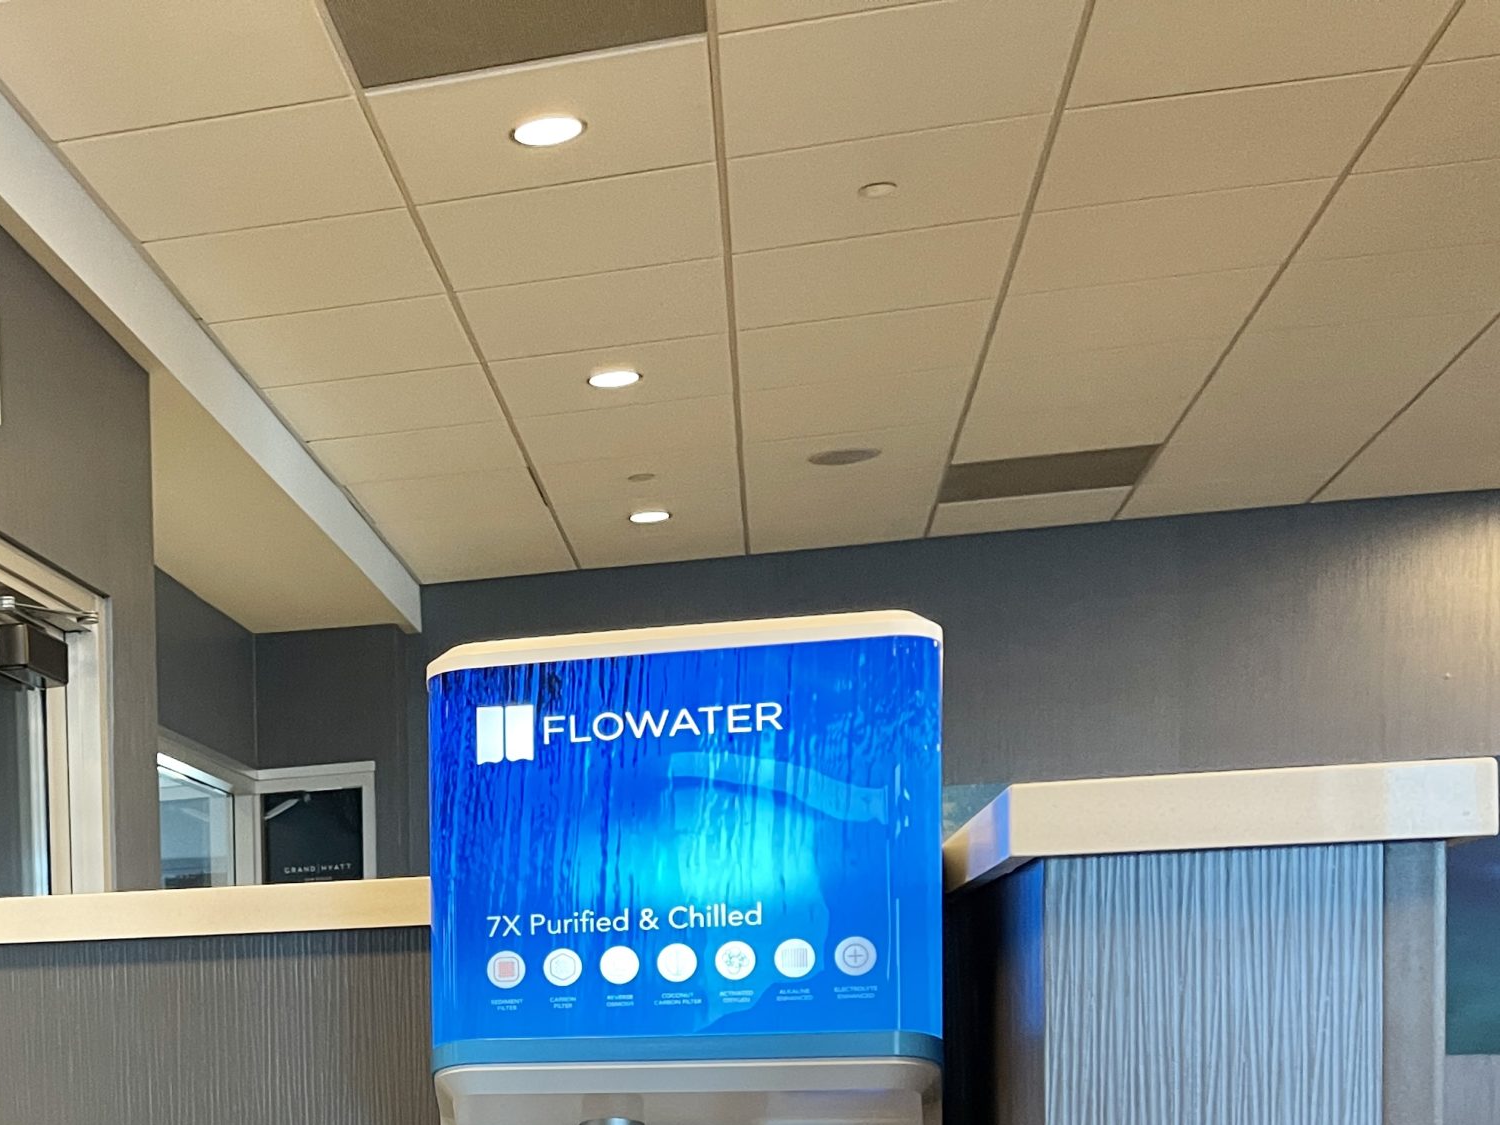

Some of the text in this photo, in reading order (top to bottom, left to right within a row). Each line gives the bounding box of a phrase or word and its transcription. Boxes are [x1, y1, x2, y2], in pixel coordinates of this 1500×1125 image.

[543, 701, 784, 745] FLOWATER
[283, 862, 352, 874] GRAND HYATT
[486, 902, 763, 938] 7X Purified & Chilled
